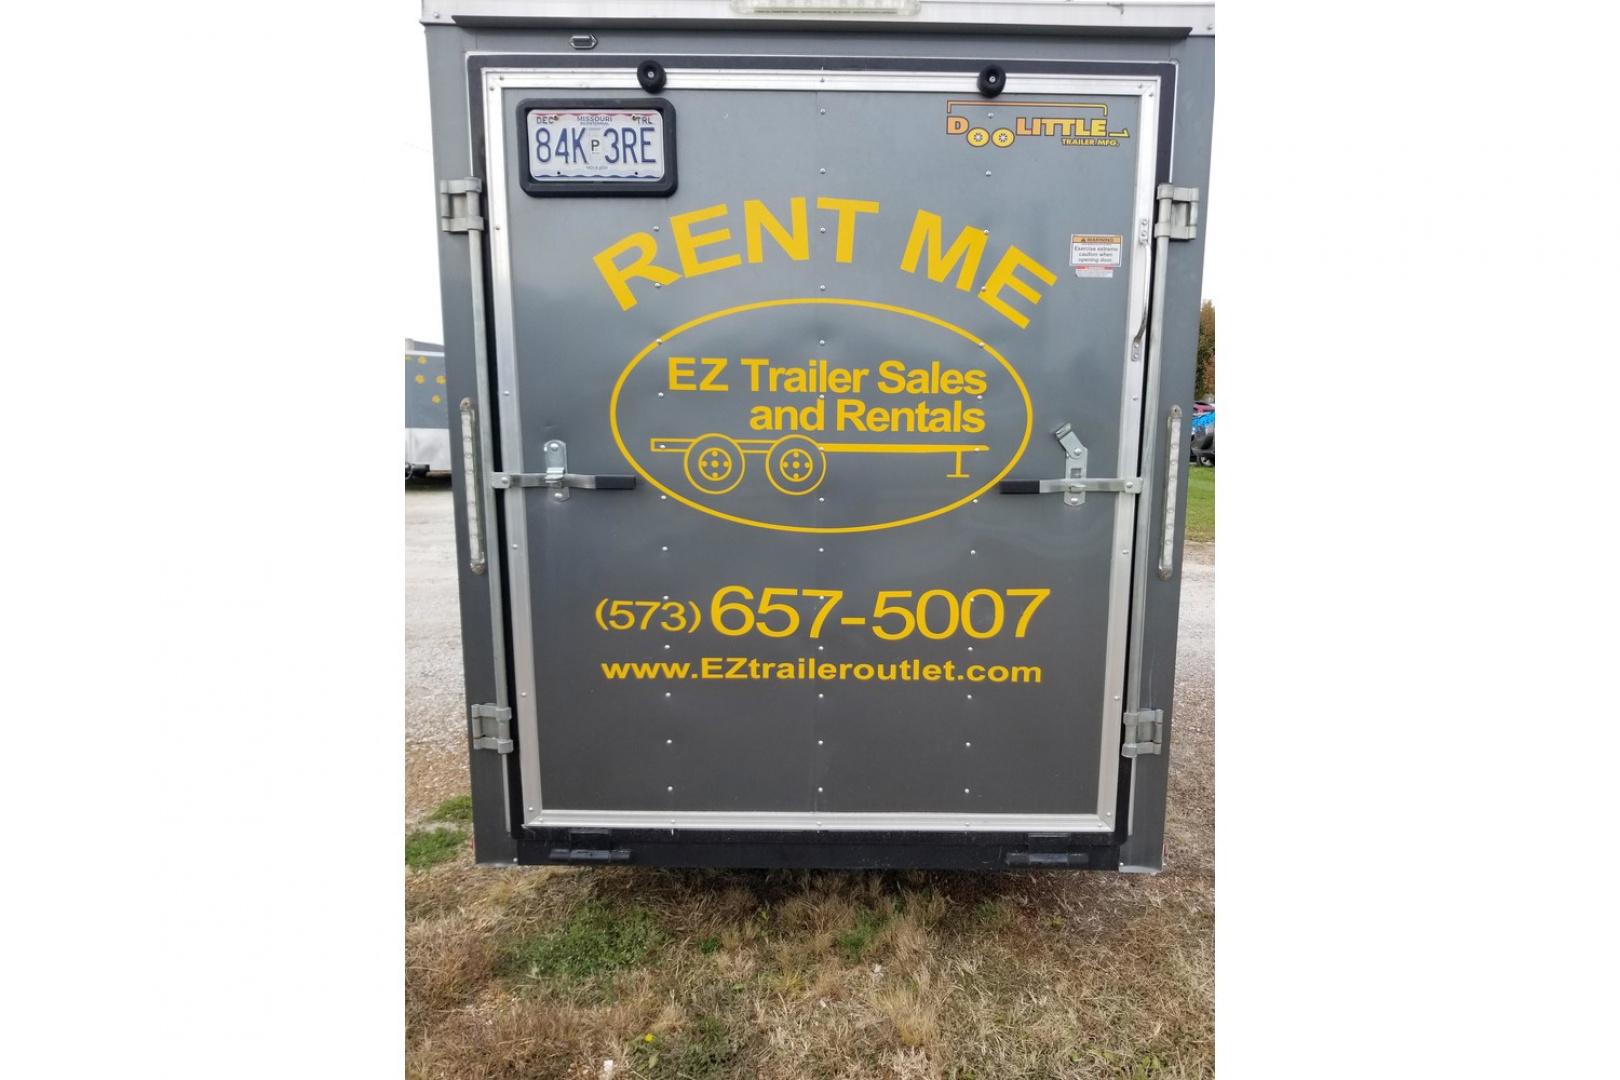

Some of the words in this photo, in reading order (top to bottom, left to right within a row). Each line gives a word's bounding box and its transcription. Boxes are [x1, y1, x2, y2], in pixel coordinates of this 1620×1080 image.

[536, 116, 554, 125] DEC
[636, 116, 653, 125] TRL
[535, 127, 588, 164] 84K
[591, 139, 600, 151] P
[603, 127, 656, 164] 3RE
[1061, 138, 1095, 146] TRAILER
[1097, 138, 1120, 147] MFG.
[593, 197, 880, 311] RENT
[900, 209, 1057, 329] ME
[668, 356, 729, 392] EZ
[740, 357, 870, 394] Trailer
[877, 359, 988, 396] Sales
[749, 398, 826, 432] and
[835, 398, 986, 434] Rentals
[594, 597, 702, 634] (573)
[709, 584, 1051, 641] 657-5007
[600, 656, 1043, 684] www.EZtraileroutlet.com
